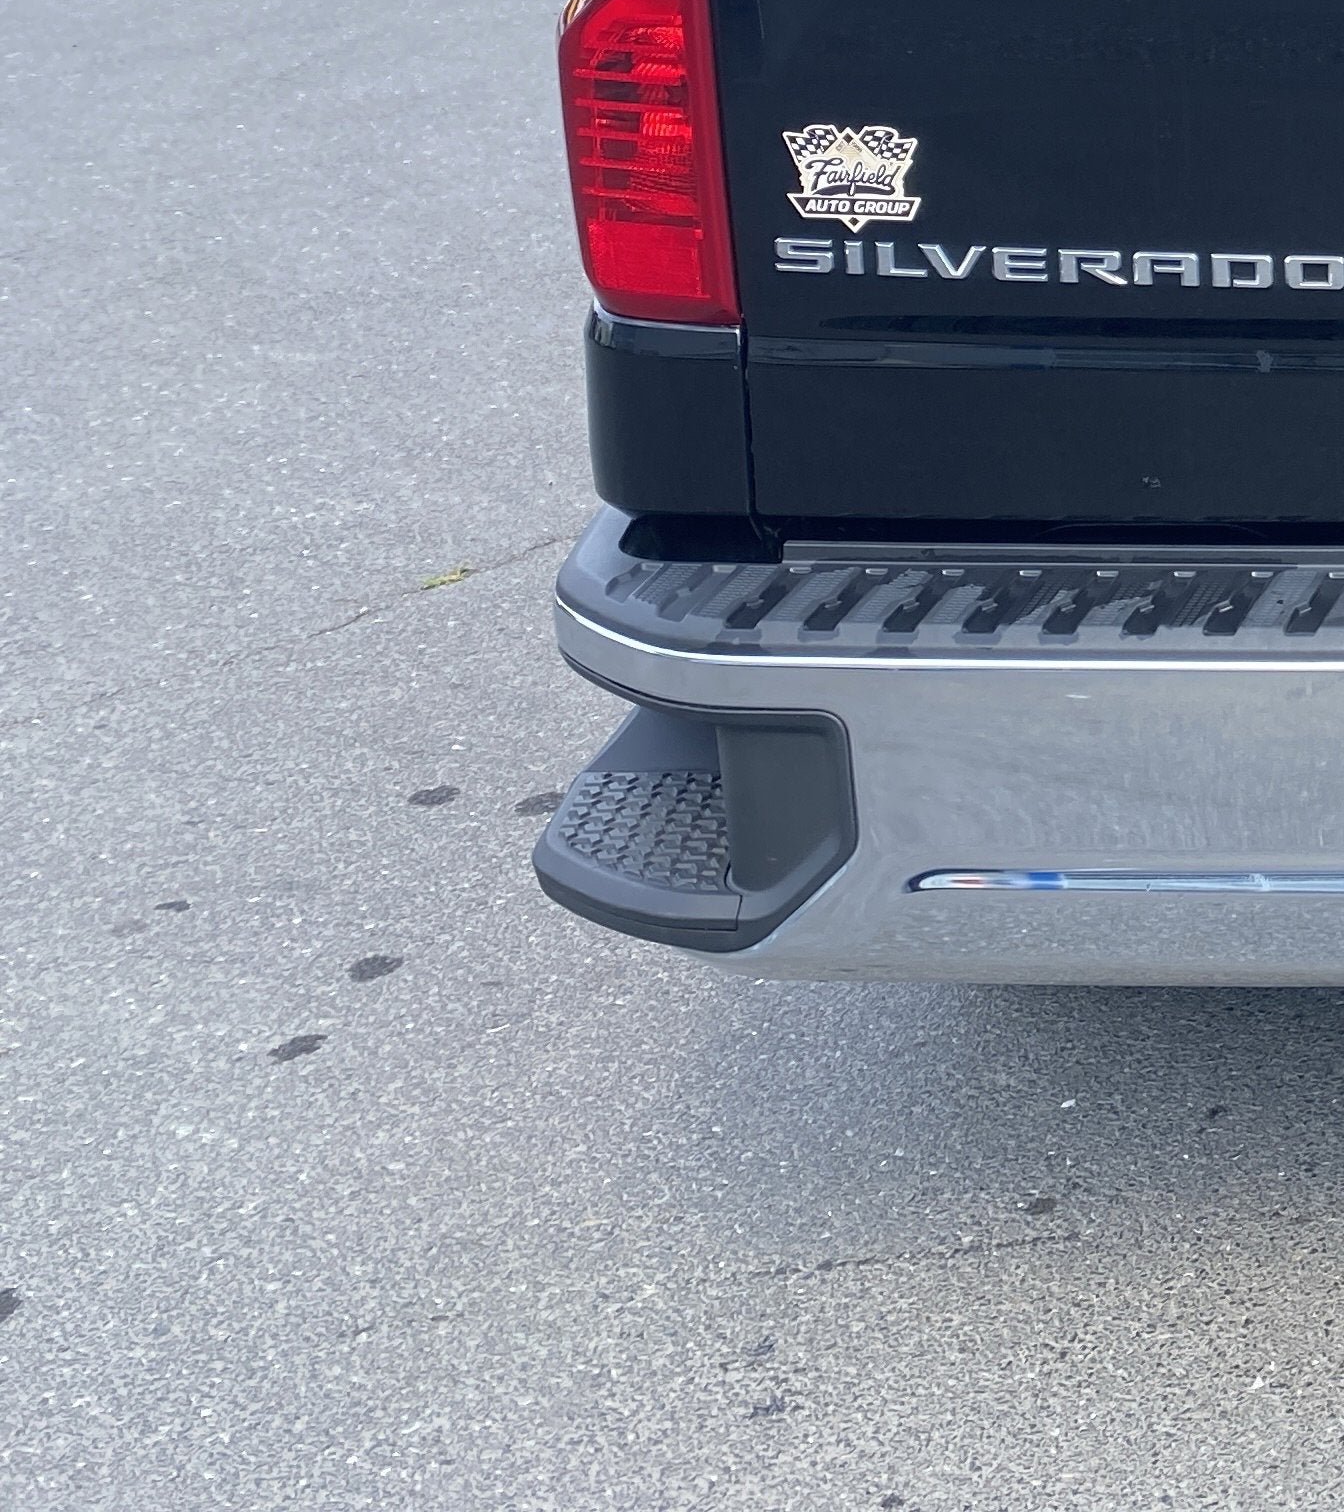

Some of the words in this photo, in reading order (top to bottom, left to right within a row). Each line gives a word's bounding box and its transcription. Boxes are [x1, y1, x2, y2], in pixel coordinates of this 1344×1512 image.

[805, 157, 902, 196] Fairfield
[804, 199, 850, 213] AUTO
[853, 200, 911, 215] GROUP
